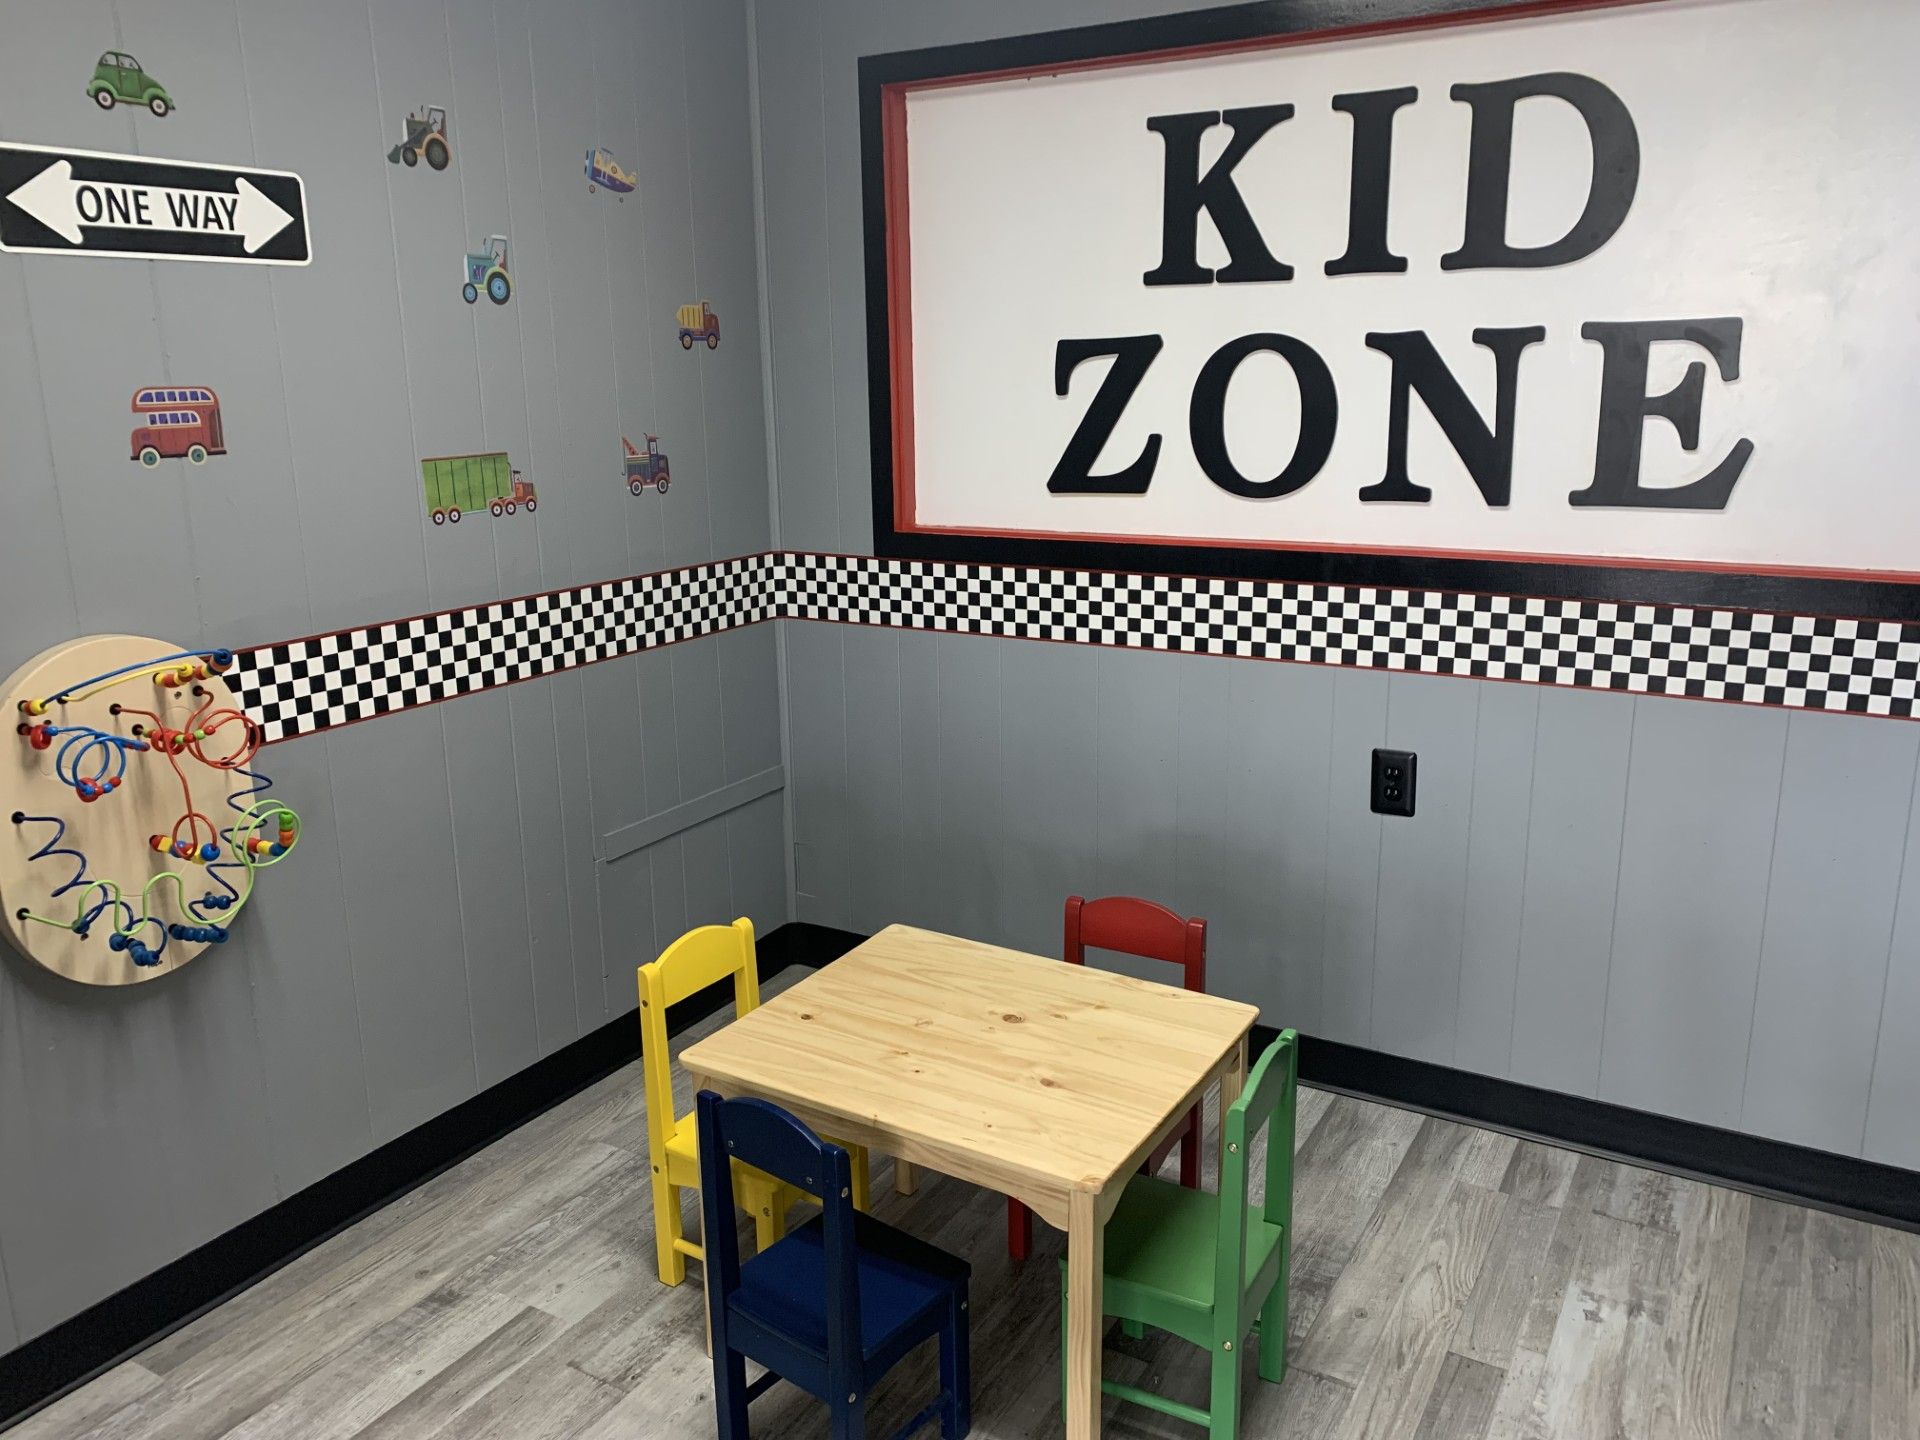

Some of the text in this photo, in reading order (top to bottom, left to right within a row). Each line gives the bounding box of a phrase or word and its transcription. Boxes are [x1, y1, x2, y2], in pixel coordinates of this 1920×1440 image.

[76, 184, 238, 232] ONE WAY
[1143, 72, 1640, 287] KID
[1046, 317, 1755, 511] ZONE
